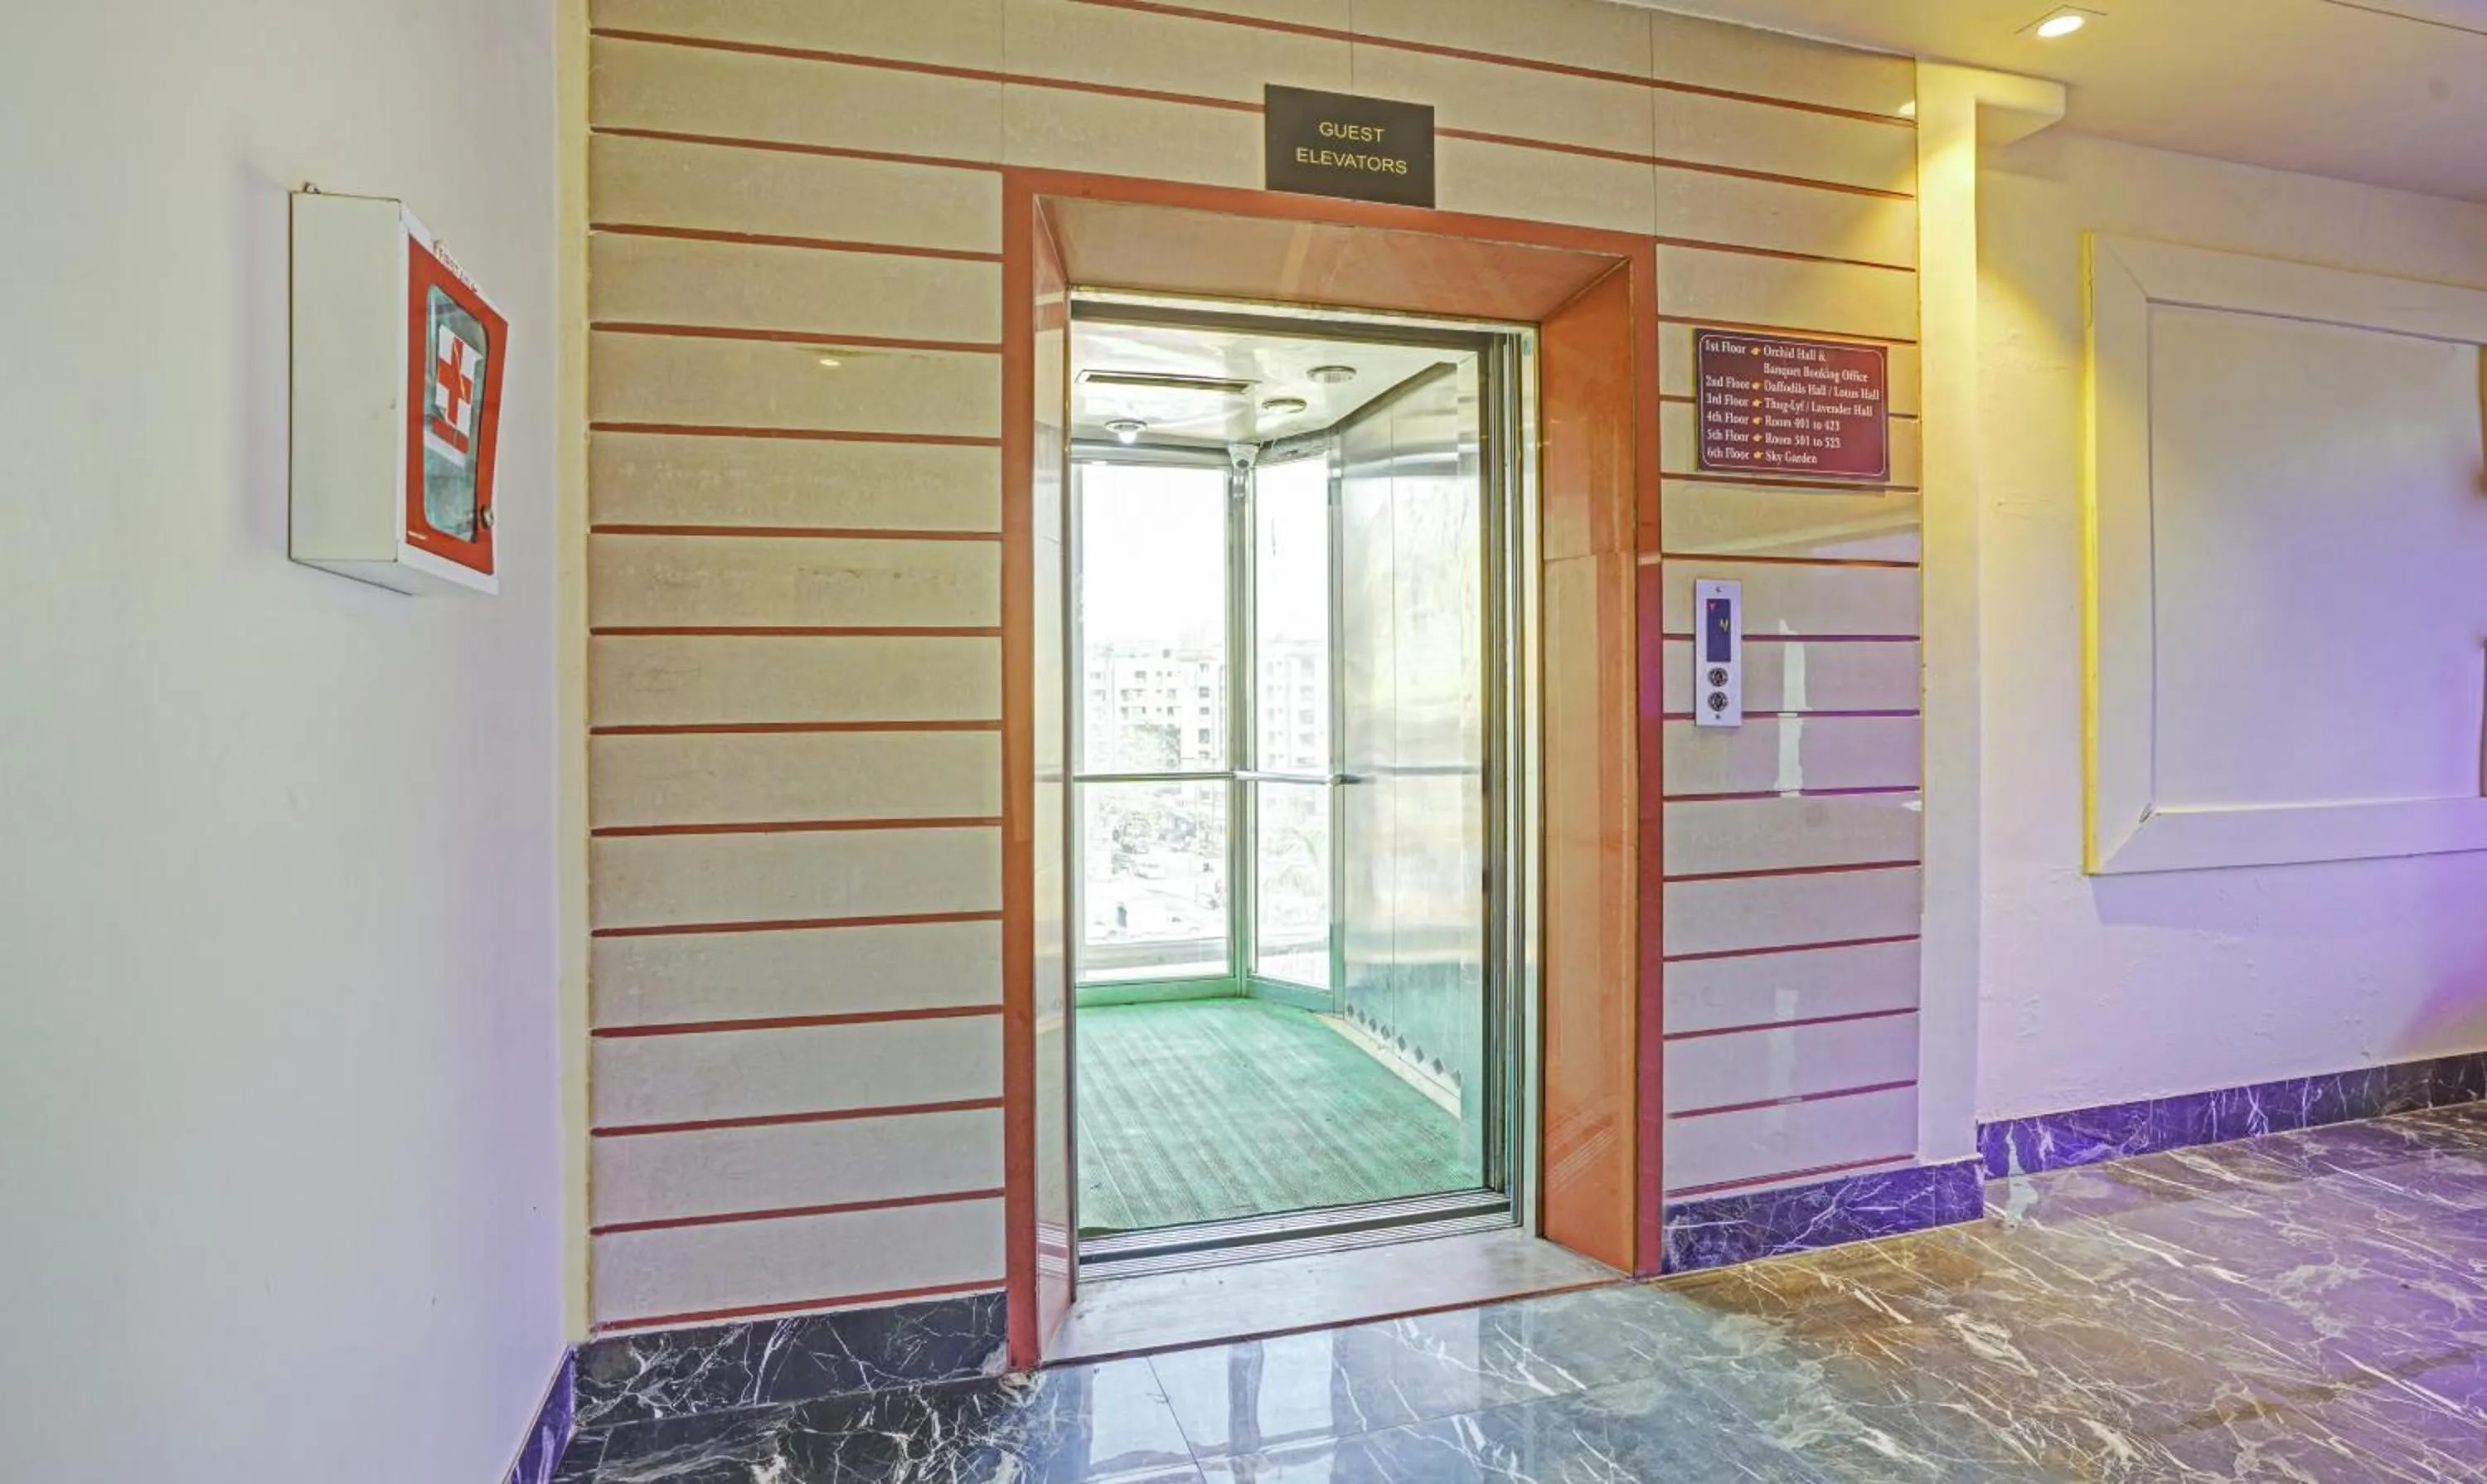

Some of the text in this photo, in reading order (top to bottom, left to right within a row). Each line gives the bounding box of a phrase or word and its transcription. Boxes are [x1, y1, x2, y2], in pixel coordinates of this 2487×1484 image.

[1319, 122, 1384, 142] GUEST
[1296, 147, 1408, 175] ELEVATORS
[1705, 340, 1827, 362] 1st Floor Orchid Hall &
[1763, 362, 1869, 383] Banquet Booking Office
[1705, 375, 1724, 387] 2nd
[1726, 376, 1750, 389] Floor
[1764, 380, 1806, 394] Daffodils
[1808, 384, 1827, 395] Hall
[1834, 385, 1859, 398] Lotus
[1861, 388, 1880, 400] Hall
[1705, 393, 1722, 405] 3rd
[1724, 394, 1750, 406] Floor
[1811, 401, 1852, 415] Lavender
[1853, 405, 1873, 417] Hall
[1706, 411, 1723, 422] 4th
[1725, 412, 1750, 425] Floor
[1765, 415, 1792, 428] Room
[1793, 417, 1810, 429] 401
[1813, 419, 1823, 430] to
[1707, 429, 1723, 440] 5th
[1725, 429, 1750, 442] Floor
[1765, 432, 1792, 445] Room
[1794, 434, 1811, 446] 501
[1813, 437, 1823, 448] to
[1707, 446, 1818, 464] 6th Floor Sky Garden
